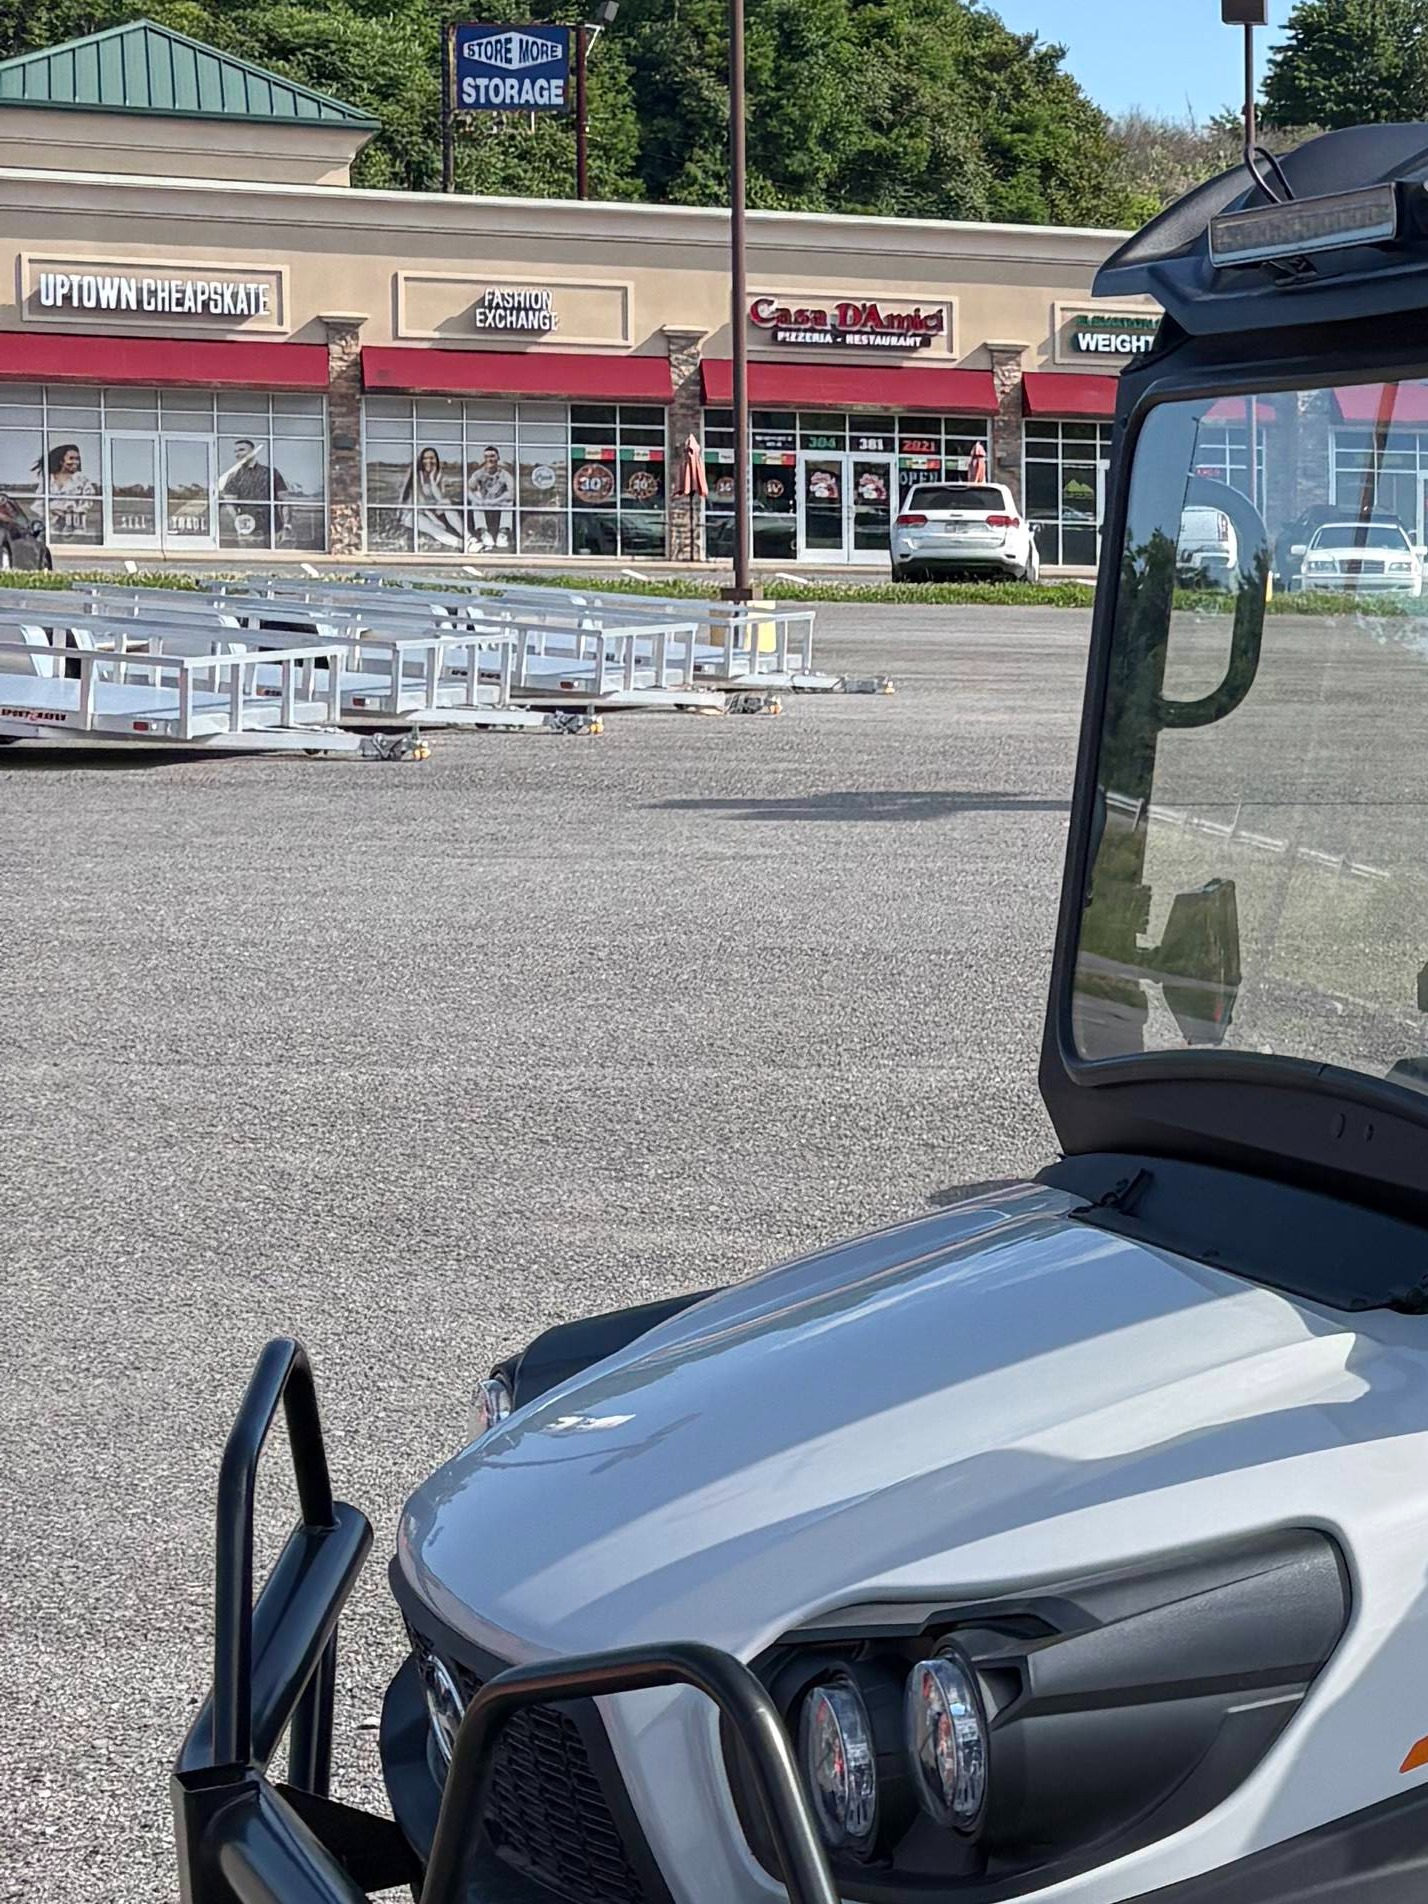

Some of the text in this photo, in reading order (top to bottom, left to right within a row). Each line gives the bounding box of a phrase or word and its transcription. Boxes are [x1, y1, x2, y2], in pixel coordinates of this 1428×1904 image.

[468, 37, 559, 65] STORE MORE
[462, 77, 564, 105] STORAGE
[40, 273, 270, 315] UPTOWN CHEAPSKATE
[485, 288, 553, 311] FASHION
[475, 308, 560, 331] EXCHANGE
[750, 298, 945, 334] Casa D'Amici
[777, 330, 833, 344] PIZZERIA
[845, 334, 922, 347] RESTAURANT
[859, 438, 884, 451] 381
